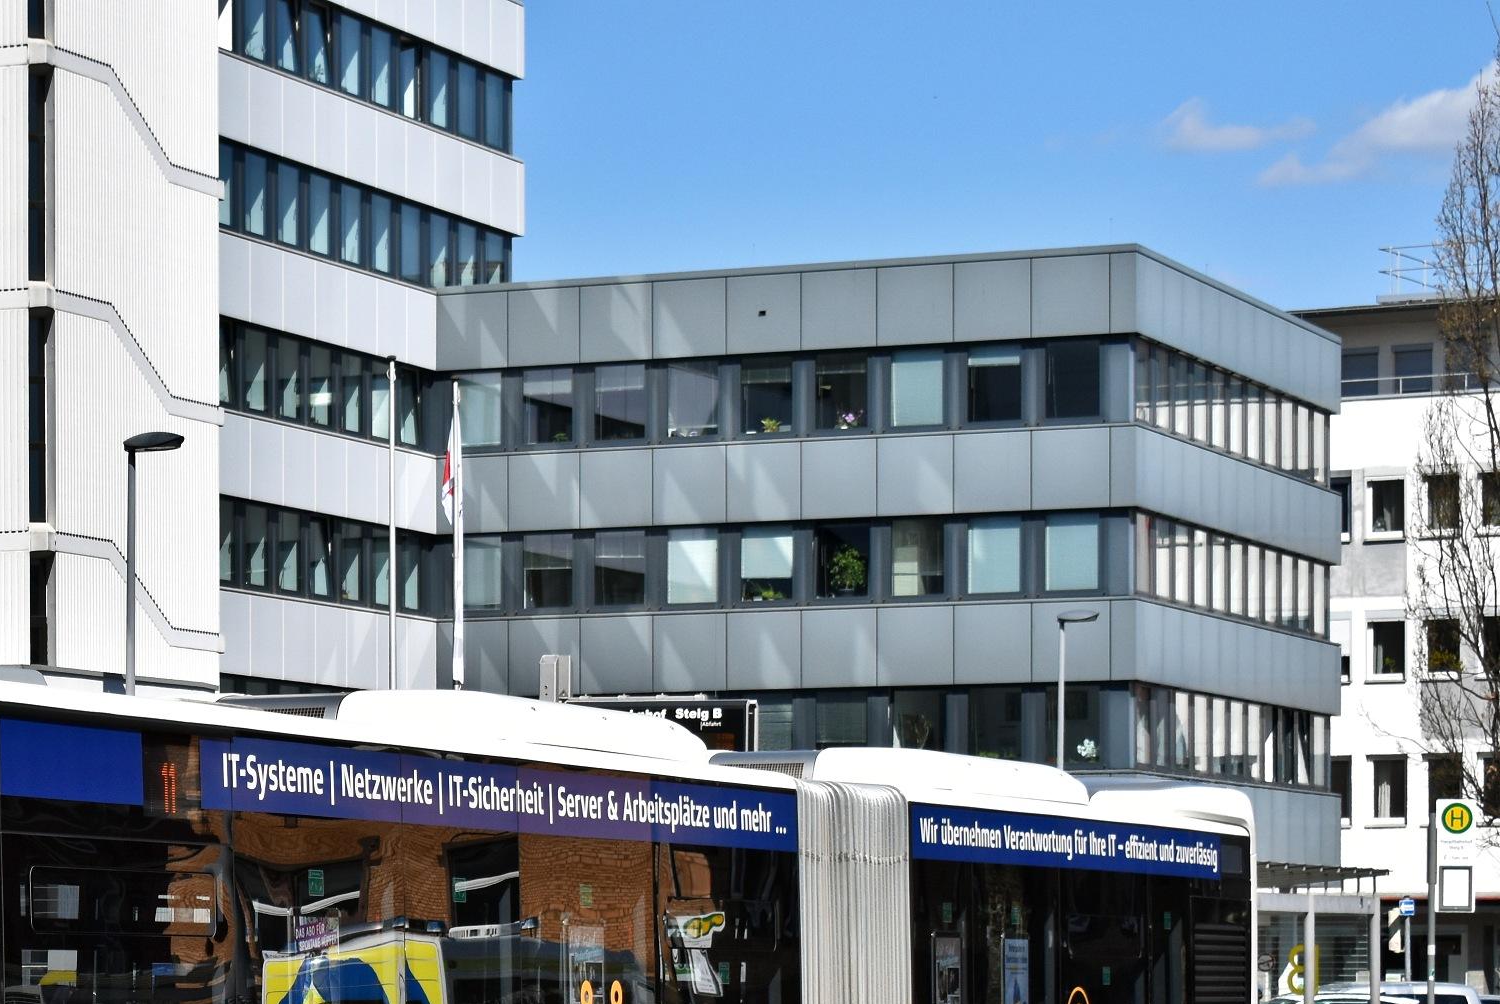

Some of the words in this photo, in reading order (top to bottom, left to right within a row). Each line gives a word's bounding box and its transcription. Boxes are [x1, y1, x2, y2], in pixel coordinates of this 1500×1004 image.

[675, 708, 709, 721] Steig
[712, 708, 723, 719] B
[161, 763, 176, 813] 11
[222, 752, 324, 801] IT-Systeme
[341, 763, 433, 805] Netzwerke
[449, 774, 545, 815] IT-Sicherheit
[558, 786, 603, 820] Server
[607, 790, 619, 821] &
[623, 791, 710, 834] Arbeitsplätze
[713, 800, 738, 831] und
[740, 802, 773, 833] mehr
[1450, 809, 1464, 828] H
[920, 816, 938, 844] Wir
[941, 818, 1001, 849] übernehmen
[1003, 824, 1073, 860] Verantwortung
[1074, 828, 1087, 855] für
[1089, 830, 1106, 857] Ihre
[1108, 834, 1117, 857] IT
[1125, 834, 1158, 861] effizient
[1159, 838, 1174, 863] und
[1176, 841, 1218, 873] zuverlässig
[295, 927, 305, 939] DAS
